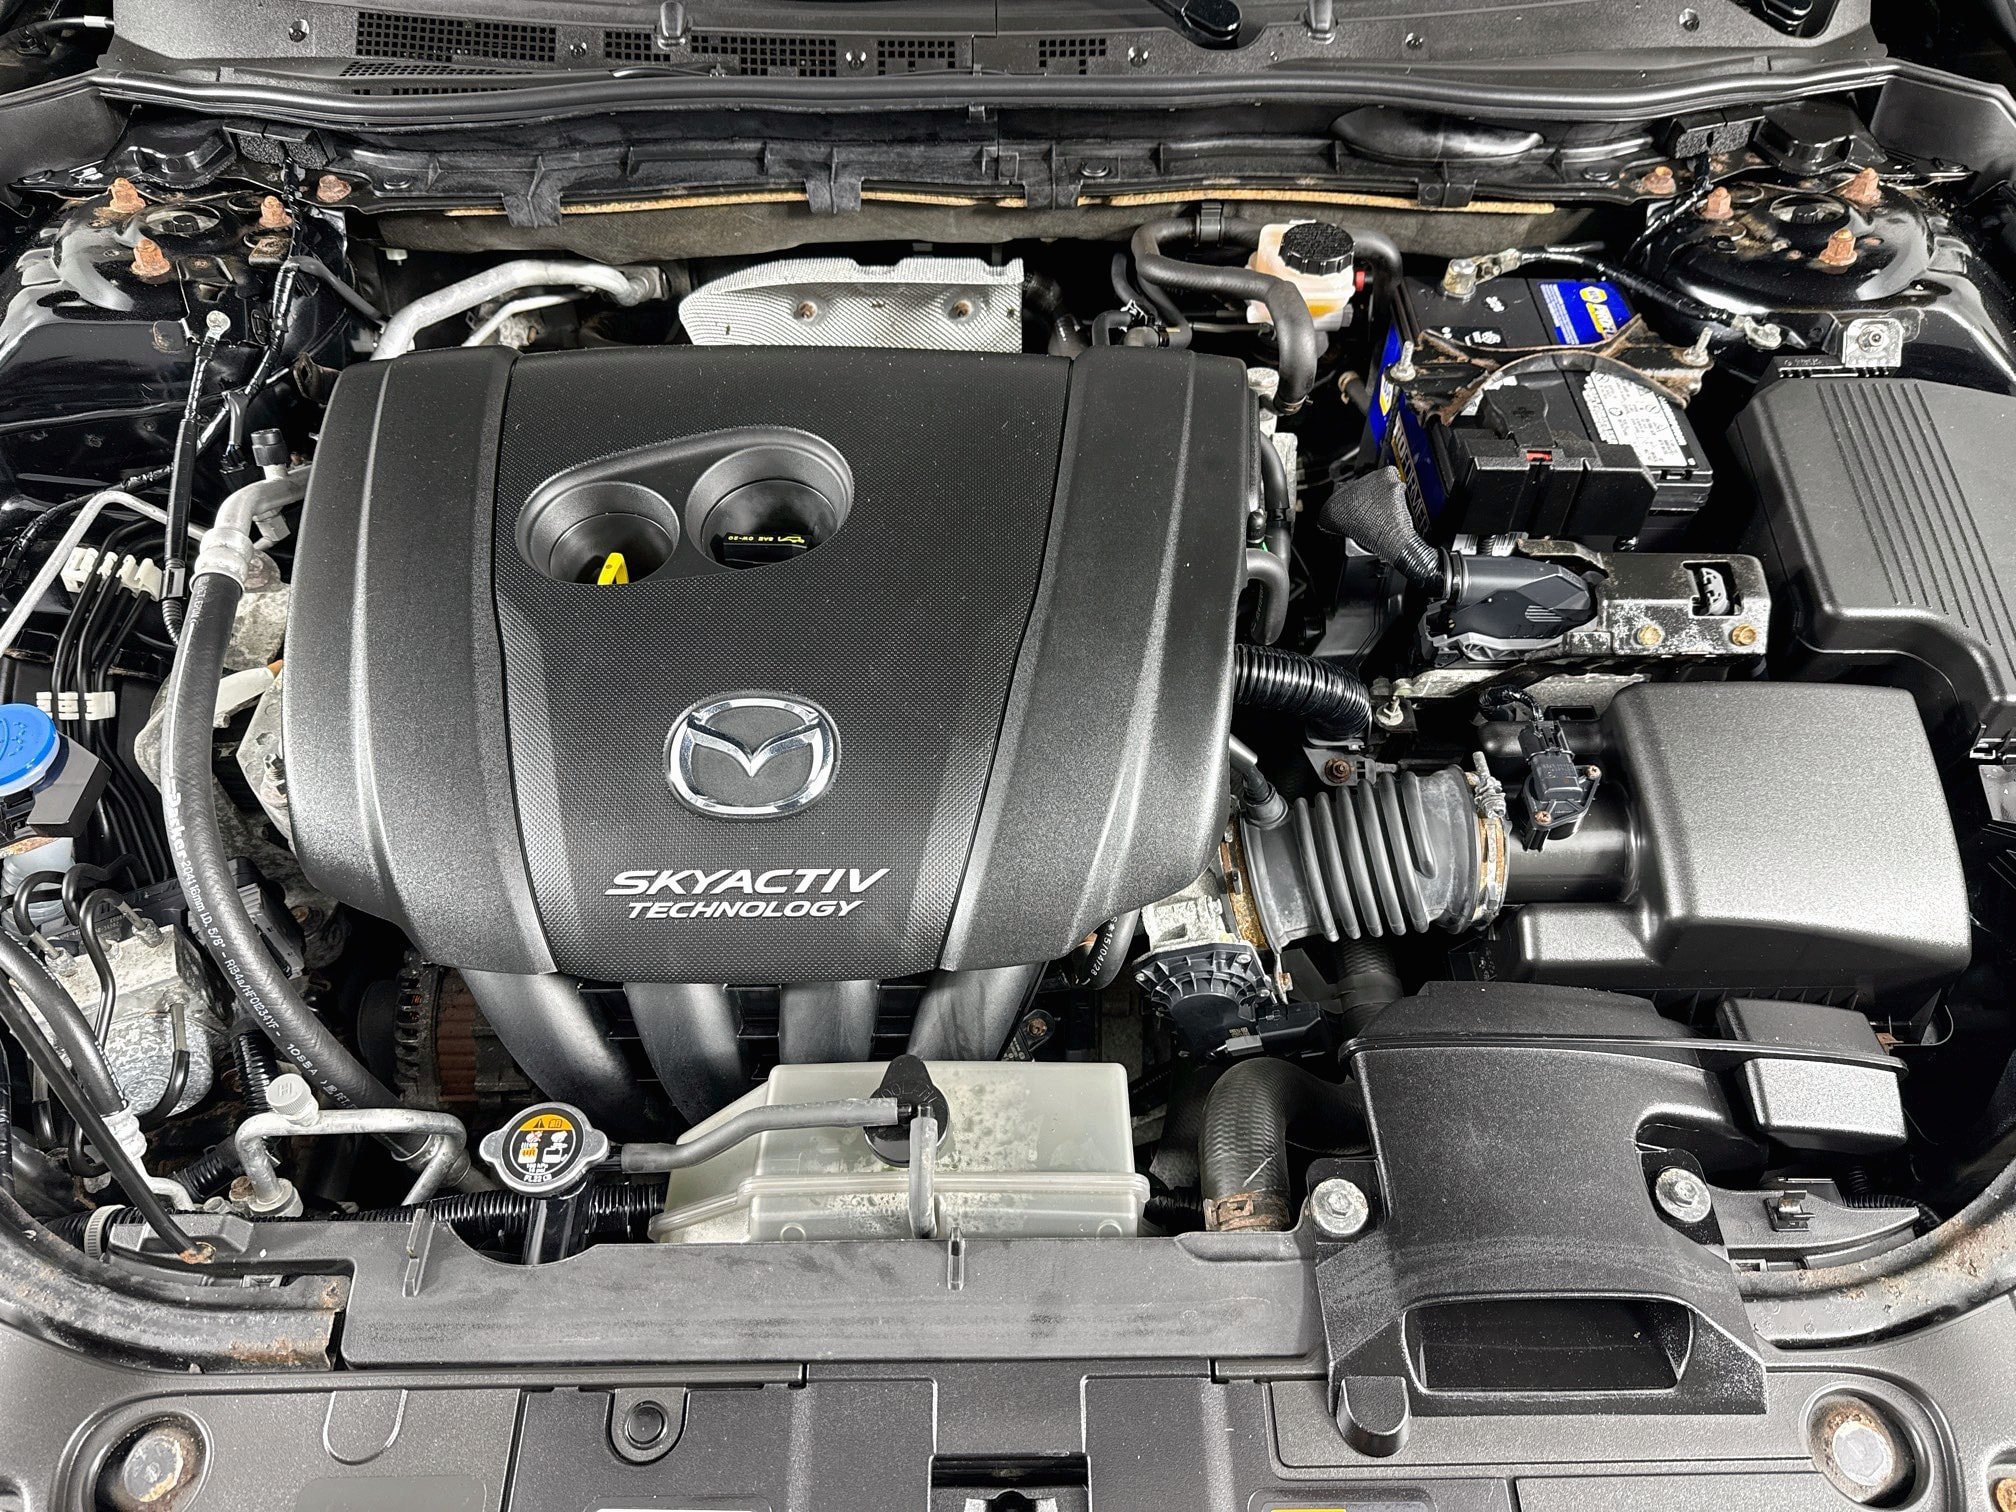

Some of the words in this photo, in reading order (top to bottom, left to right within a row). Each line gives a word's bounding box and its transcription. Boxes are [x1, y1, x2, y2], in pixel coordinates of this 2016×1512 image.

[604, 868, 891, 896] SKYACTIV
[628, 900, 867, 919] TECHNOLOGY
[523, 1174, 542, 1183] FL22
